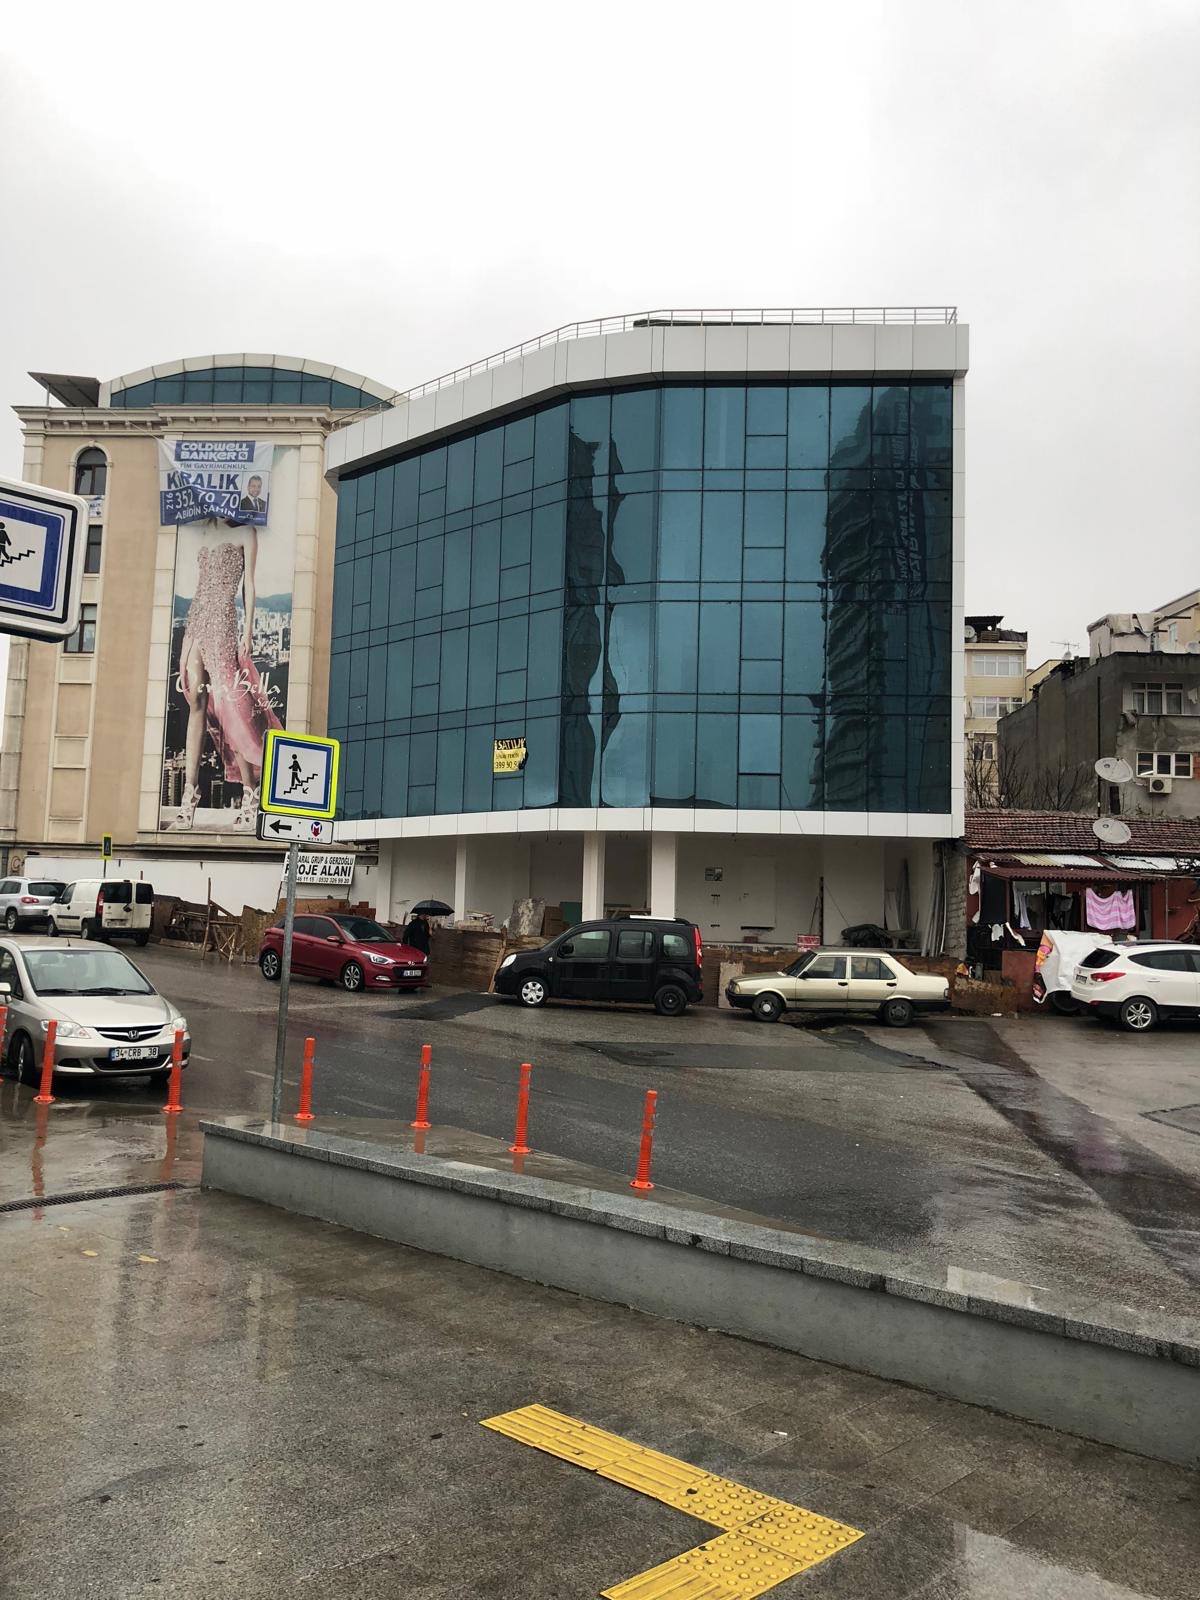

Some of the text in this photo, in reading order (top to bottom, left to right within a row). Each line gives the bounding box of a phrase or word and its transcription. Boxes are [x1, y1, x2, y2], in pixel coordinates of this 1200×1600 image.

[167, 470, 240, 490] KİRALIK
[175, 489, 195, 509] 352
[197, 489, 215, 503] 70
[220, 493, 240, 509] 70
[285, 863, 352, 877] POJE ALANI
[115, 1048, 124, 1058] 34
[128, 1048, 142, 1057] CRB
